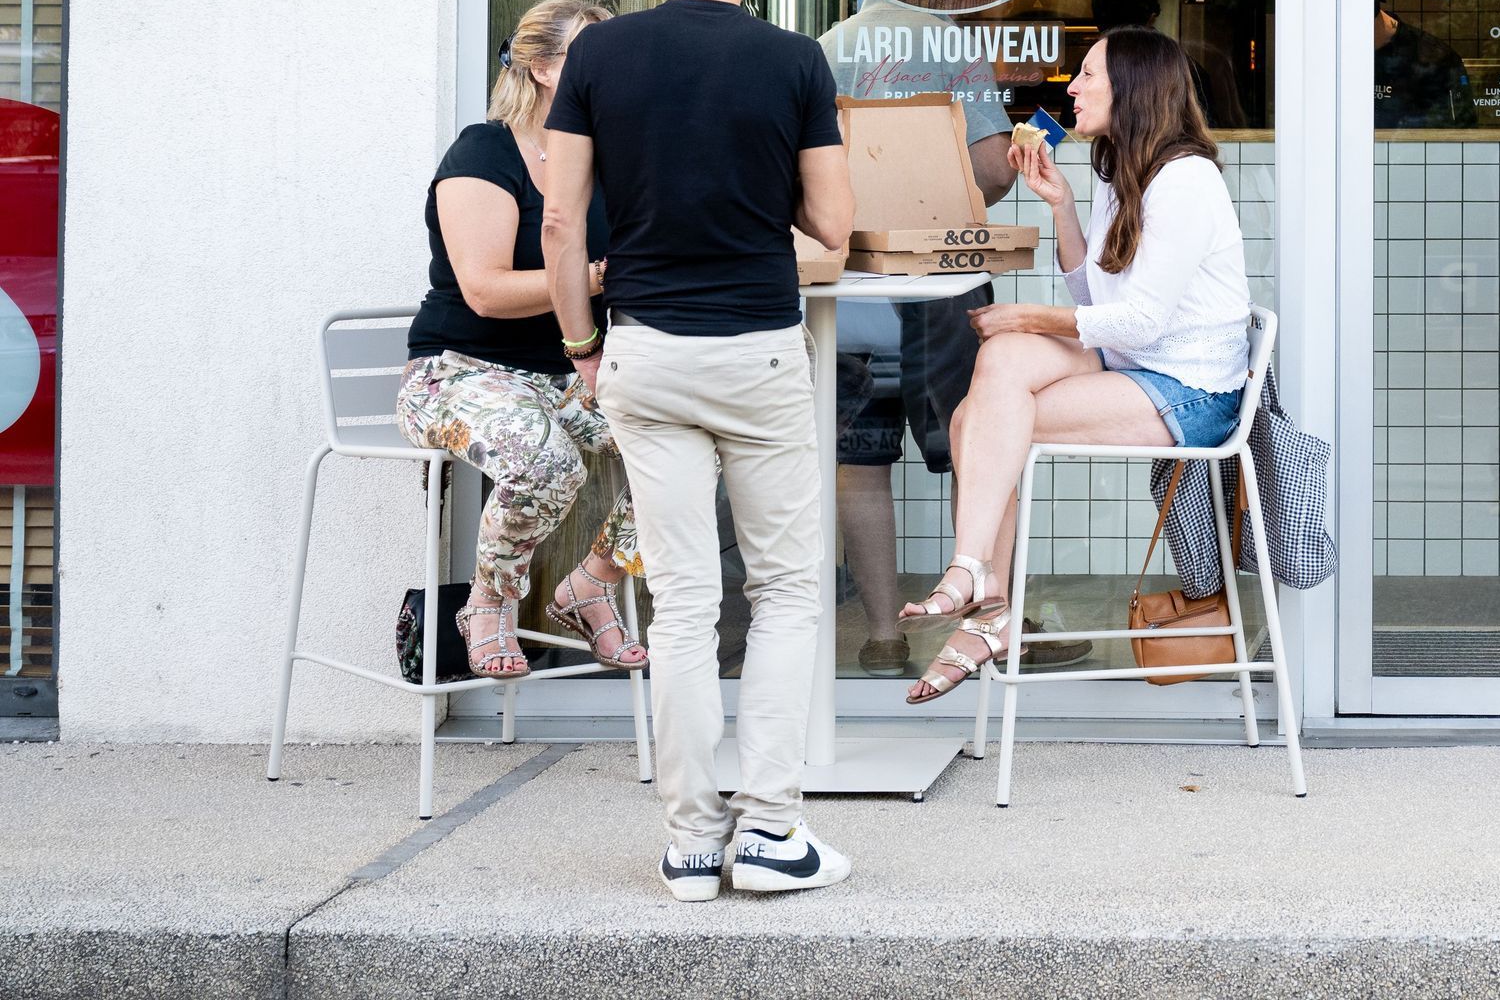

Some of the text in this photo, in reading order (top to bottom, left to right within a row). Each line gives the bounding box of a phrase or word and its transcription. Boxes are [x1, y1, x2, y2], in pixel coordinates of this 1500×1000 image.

[837, 26, 1060, 63] LARD NOUVEAU
[857, 54, 932, 96] Alsace
[945, 56, 1041, 91] Lorraine
[944, 229, 990, 246] &CO
[938, 252, 985, 269] &CO
[681, 852, 718, 869] NIKE
